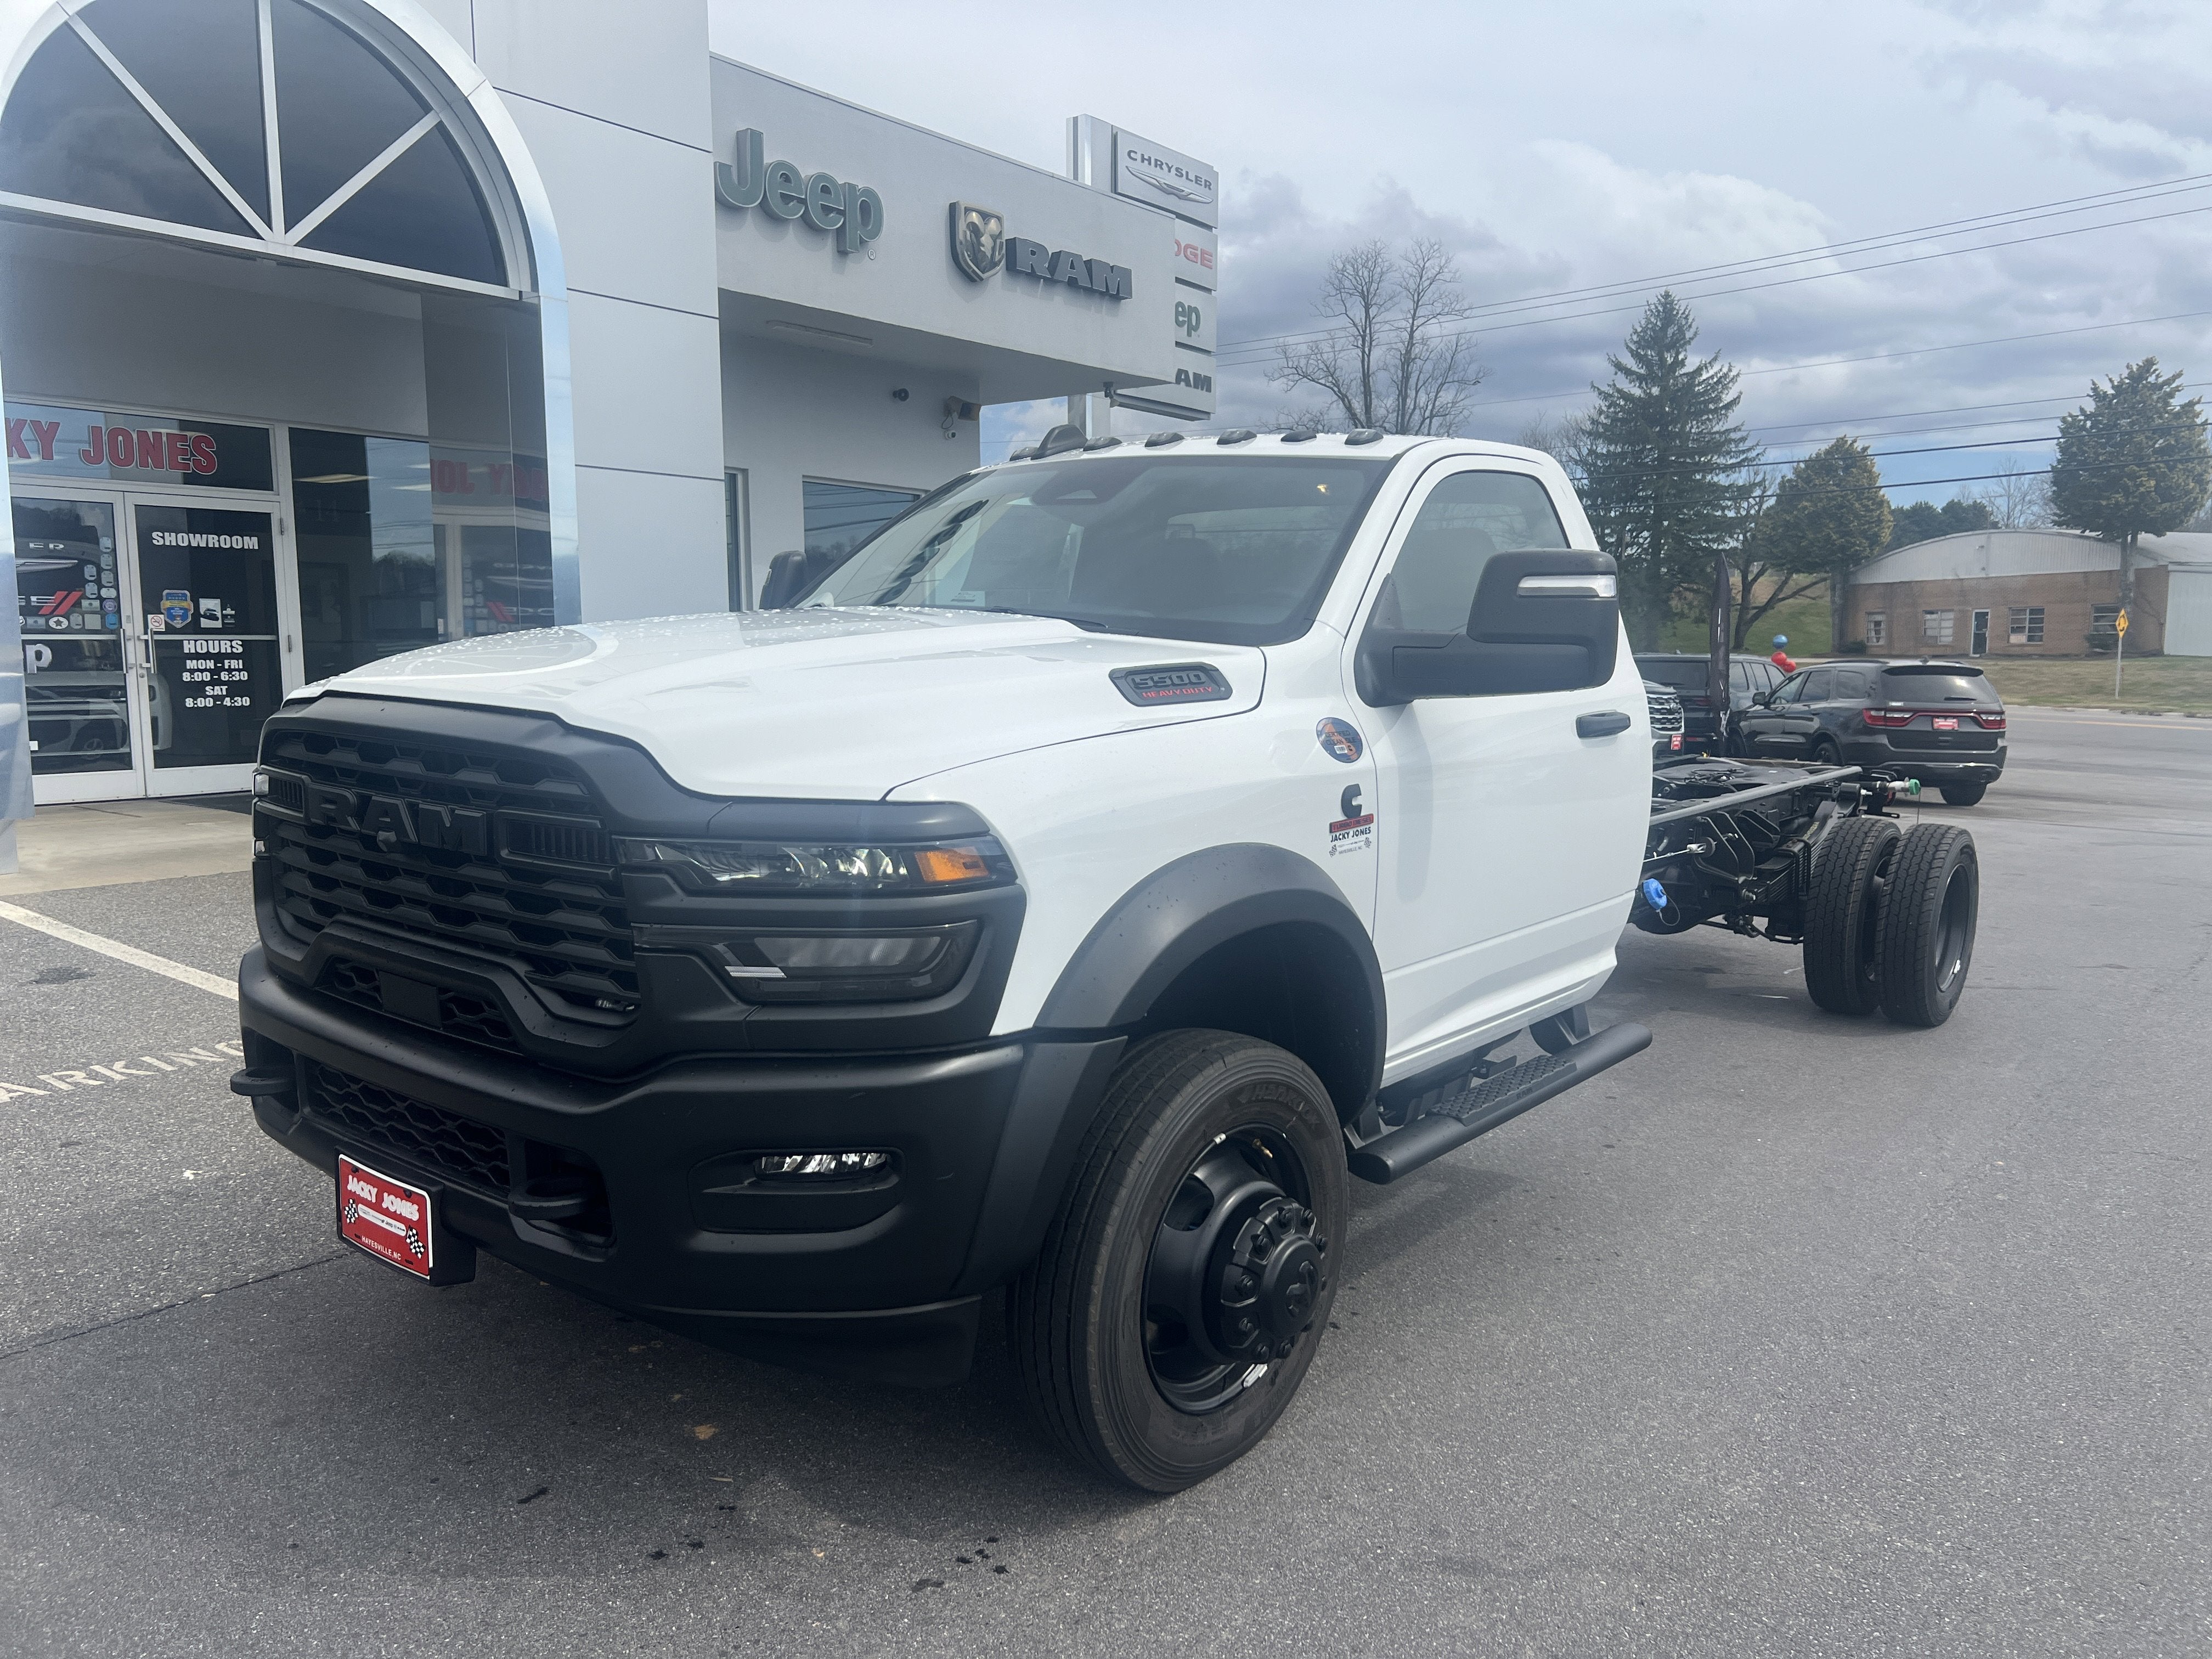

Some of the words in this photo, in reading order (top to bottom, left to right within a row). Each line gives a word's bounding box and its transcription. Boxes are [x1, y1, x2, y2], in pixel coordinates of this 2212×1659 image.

[1127, 150, 1212, 190] CHRYSLER
[714, 128, 884, 254] Jeep
[1005, 237, 1132, 299] RAM
[80, 424, 217, 475] JONES
[152, 531, 258, 550] SHOWROOM
[183, 640, 243, 653] HOURS
[186, 659, 215, 669] MON
[224, 659, 243, 669] FRI
[182, 672, 211, 681] 8:00
[220, 671, 248, 680] 6:30
[1131, 670, 1206, 690] 5500
[205, 686, 228, 695] SAT
[1142, 689, 1181, 698] HEAVY
[1182, 686, 1212, 695] DUTY
[185, 697, 213, 707] 8:00
[223, 697, 250, 706] 4:30
[309, 786, 487, 856] RAM
[1330, 831, 1350, 843] JACKY
[1351, 826, 1372, 838] JONES
[347, 1175, 378, 1203] JACKY
[382, 1192, 420, 1221] JONES
